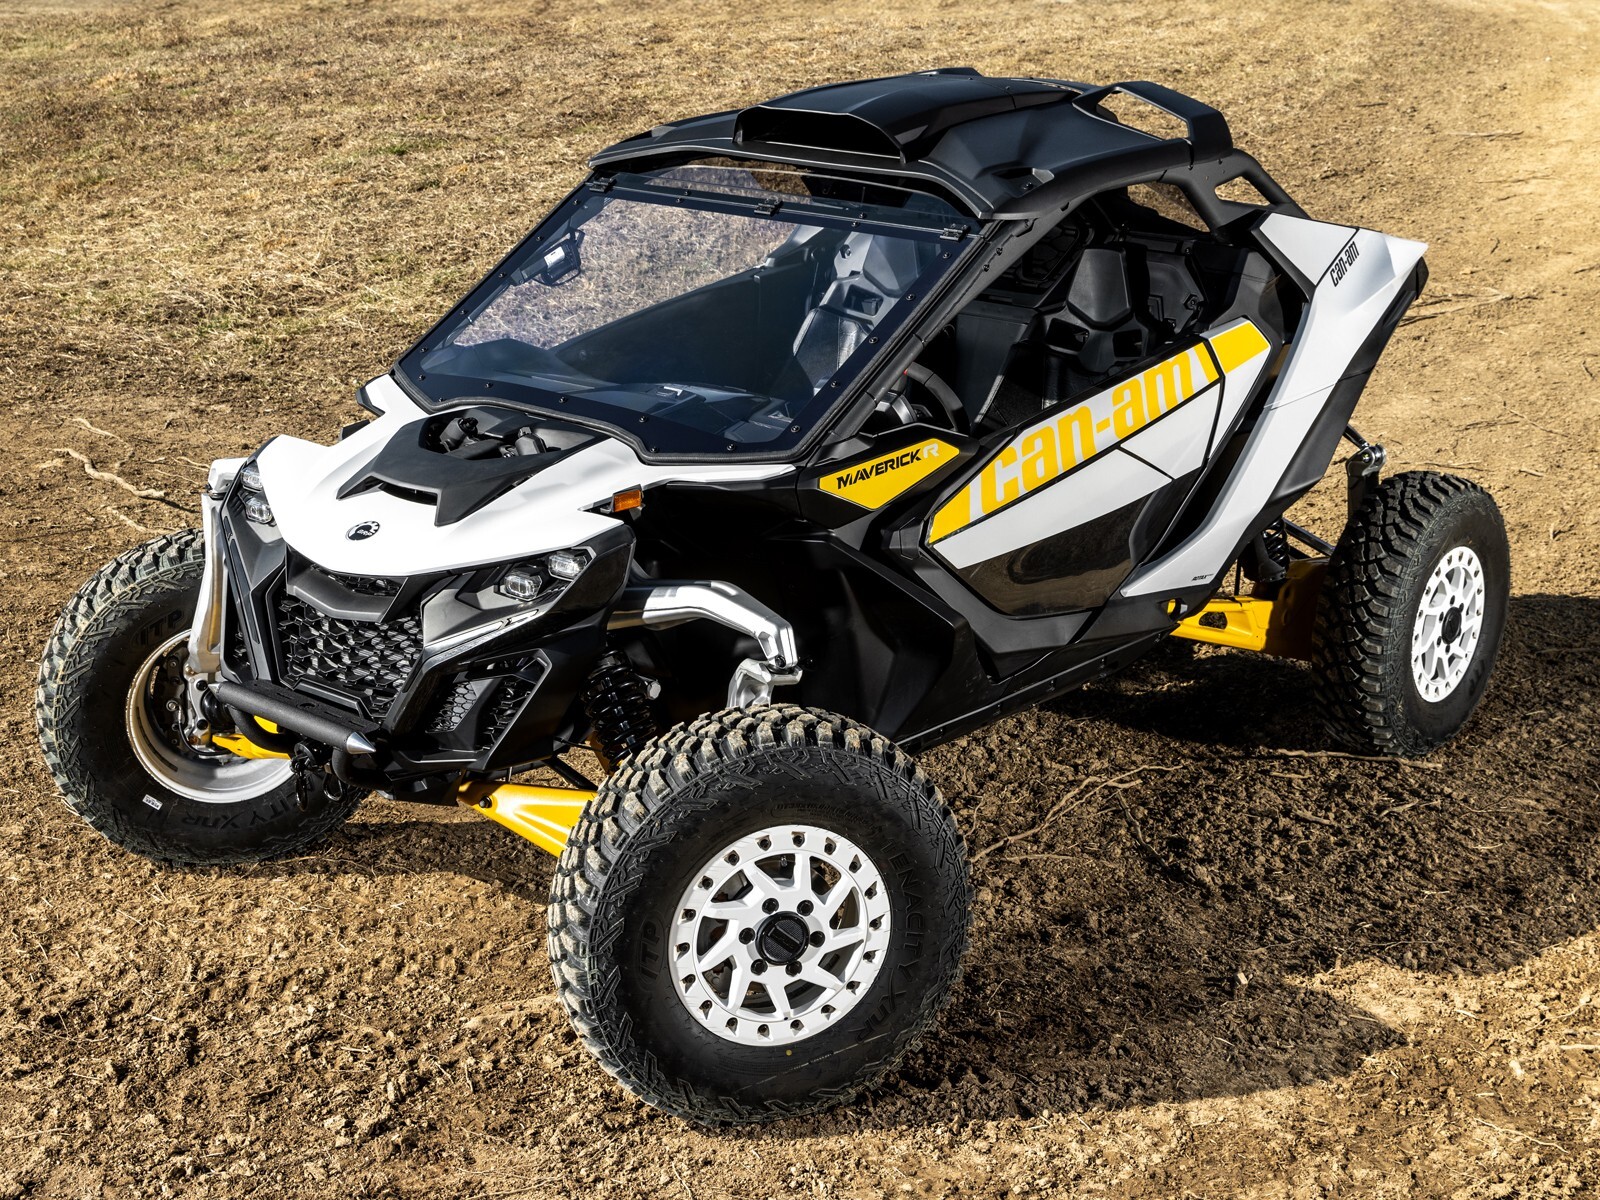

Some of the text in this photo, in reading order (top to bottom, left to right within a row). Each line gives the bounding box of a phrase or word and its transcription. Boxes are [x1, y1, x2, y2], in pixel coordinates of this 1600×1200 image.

[1329, 240, 1360, 287] can-am
[978, 350, 1195, 516] can-am
[836, 443, 939, 489] MAVERICK R
[140, 609, 183, 646] ITP
[880, 839, 925, 982] TENACITY
[640, 919, 660, 981] ITP
